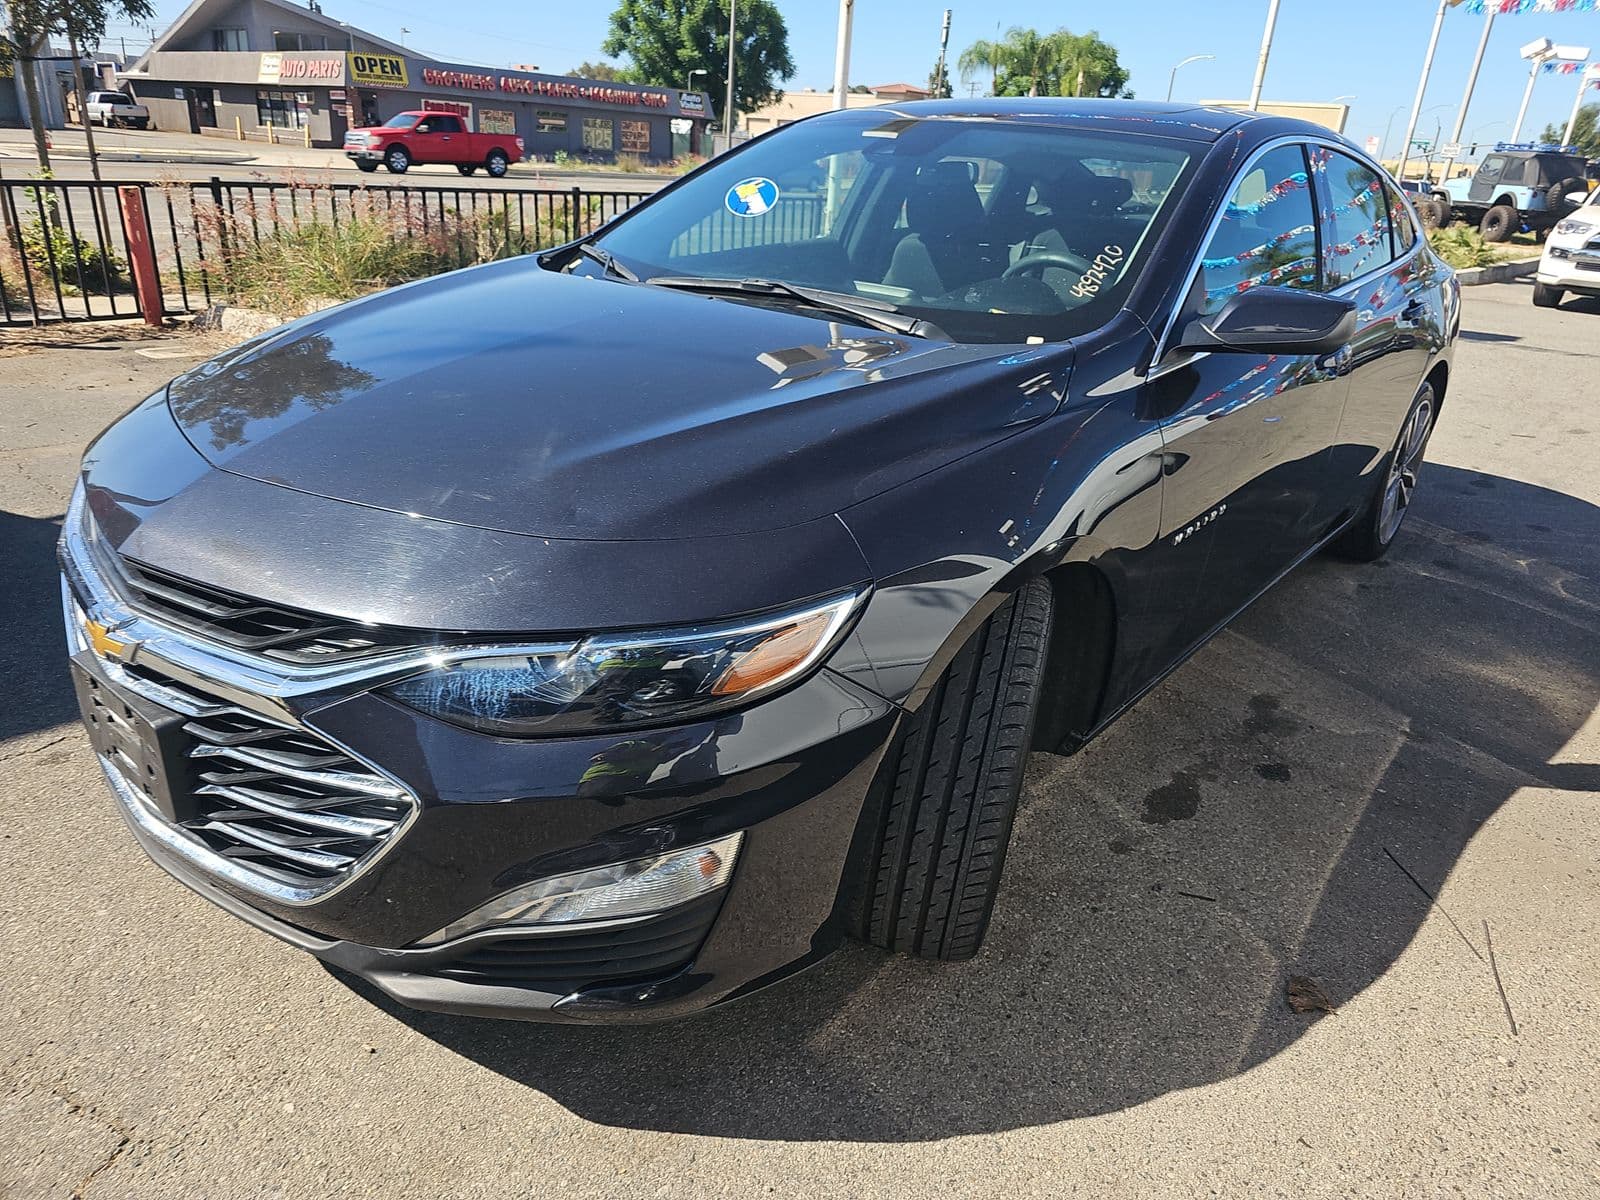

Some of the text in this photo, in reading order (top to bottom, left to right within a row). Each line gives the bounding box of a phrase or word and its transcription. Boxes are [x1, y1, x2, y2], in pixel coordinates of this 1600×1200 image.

[280, 59, 306, 78] AUTO
[307, 60, 342, 79] PARTS
[354, 56, 401, 75] OPEN
[423, 67, 497, 92] BROTHERS
[500, 76, 534, 95] AUTO
[537, 80, 579, 100] PARTS
